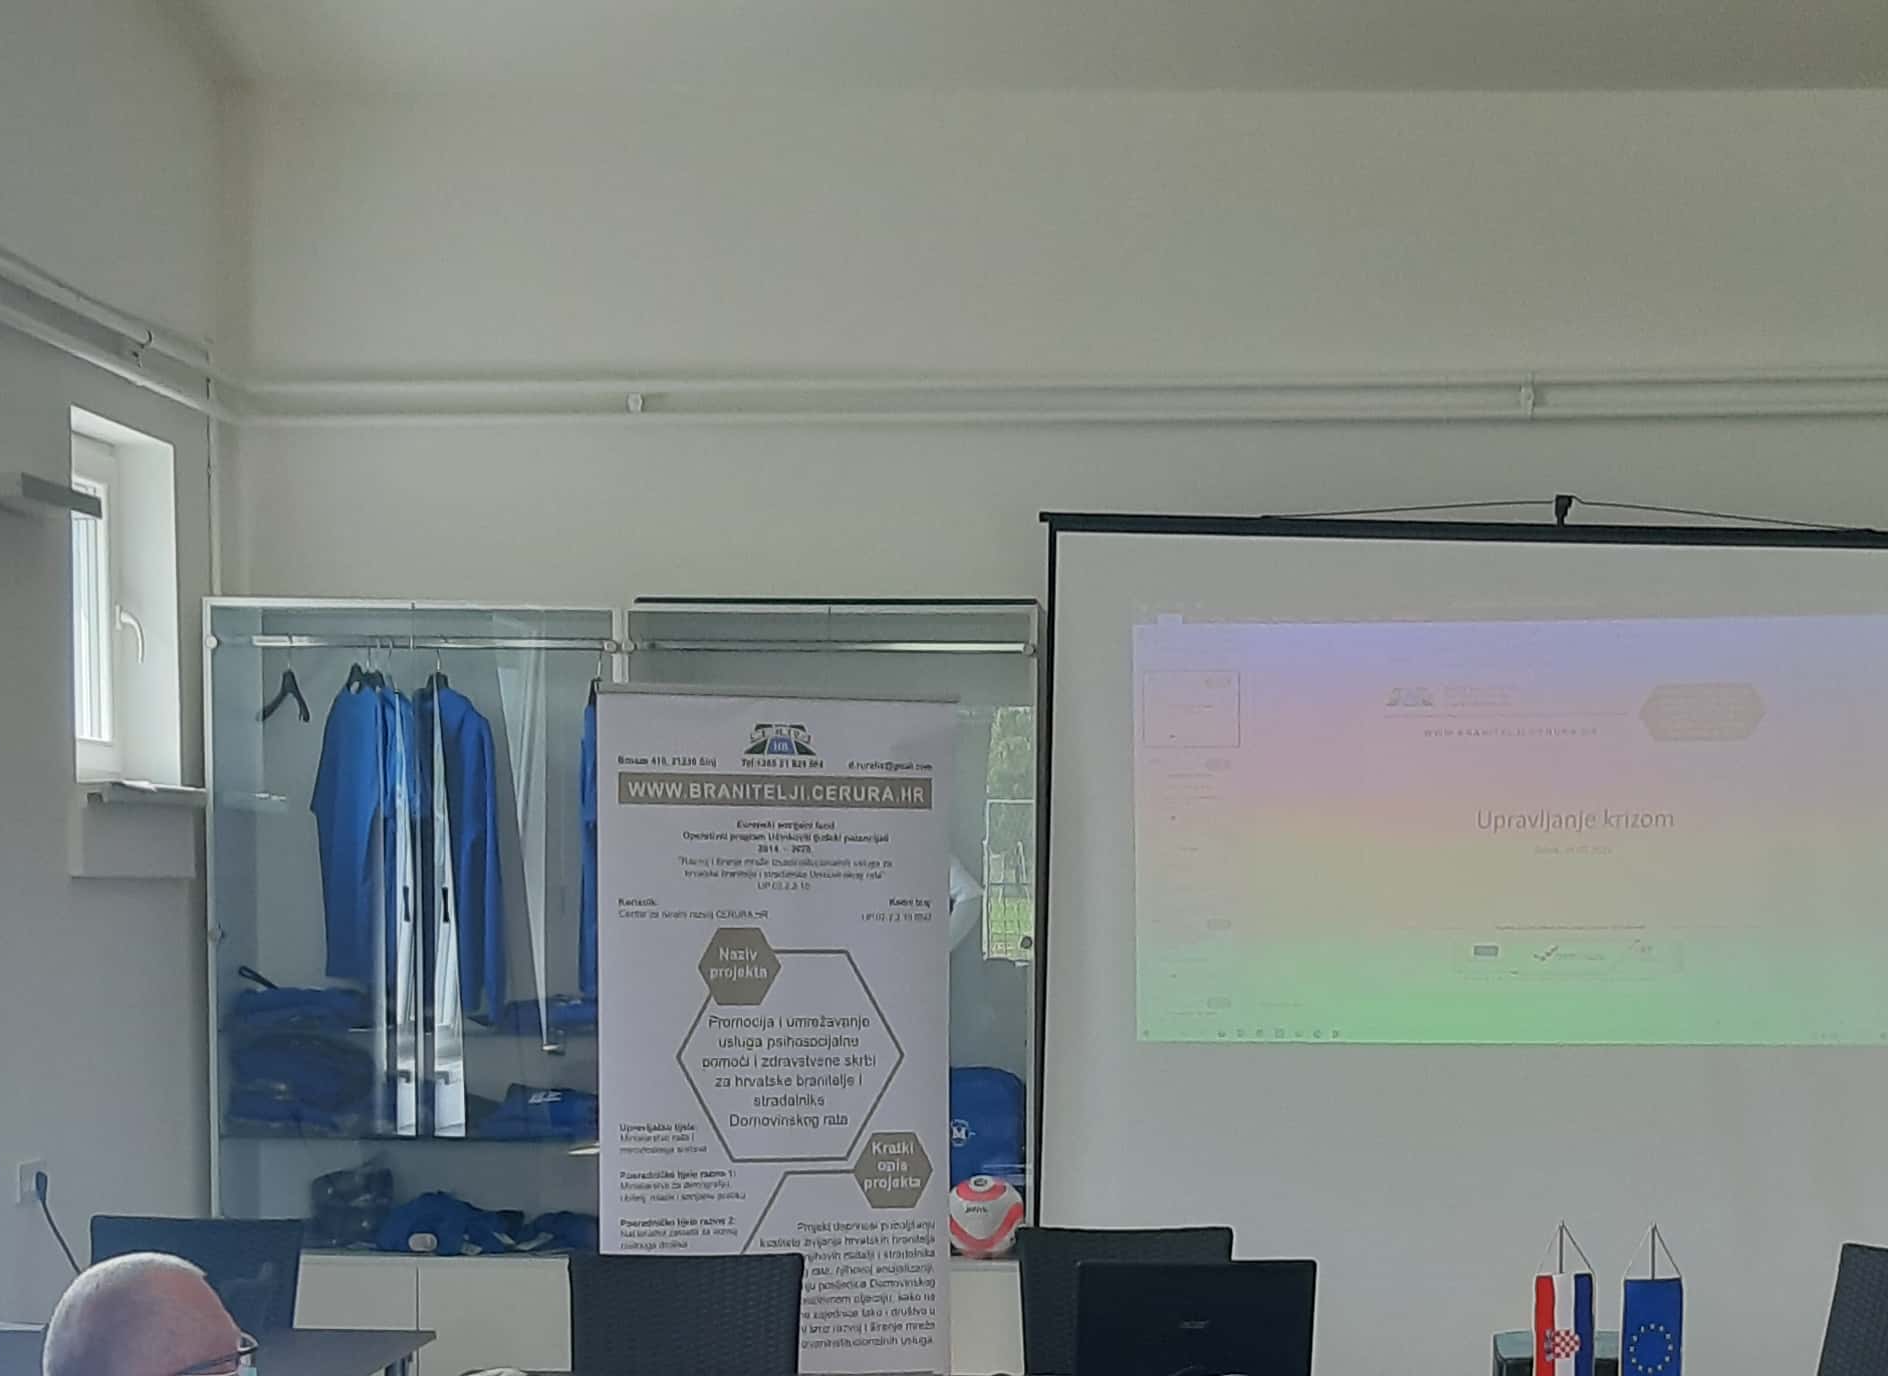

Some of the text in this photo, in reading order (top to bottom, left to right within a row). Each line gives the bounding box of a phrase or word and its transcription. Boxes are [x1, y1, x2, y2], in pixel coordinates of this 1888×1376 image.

[627, 780, 925, 803] WWW.BRANITELJI.CERURA.HR
[1477, 808, 1675, 833] Upravljanje krizom
[719, 947, 758, 961] Naziv
[710, 965, 768, 981] projekta
[709, 1015, 774, 1032] Promocija
[719, 1037, 762, 1050] usluga
[715, 1077, 731, 1088] za
[735, 1075, 792, 1088] hrvatske
[729, 1113, 820, 1128] Domovinskog
[872, 1142, 914, 1155] Kratki
[864, 1177, 921, 1192] projekta
